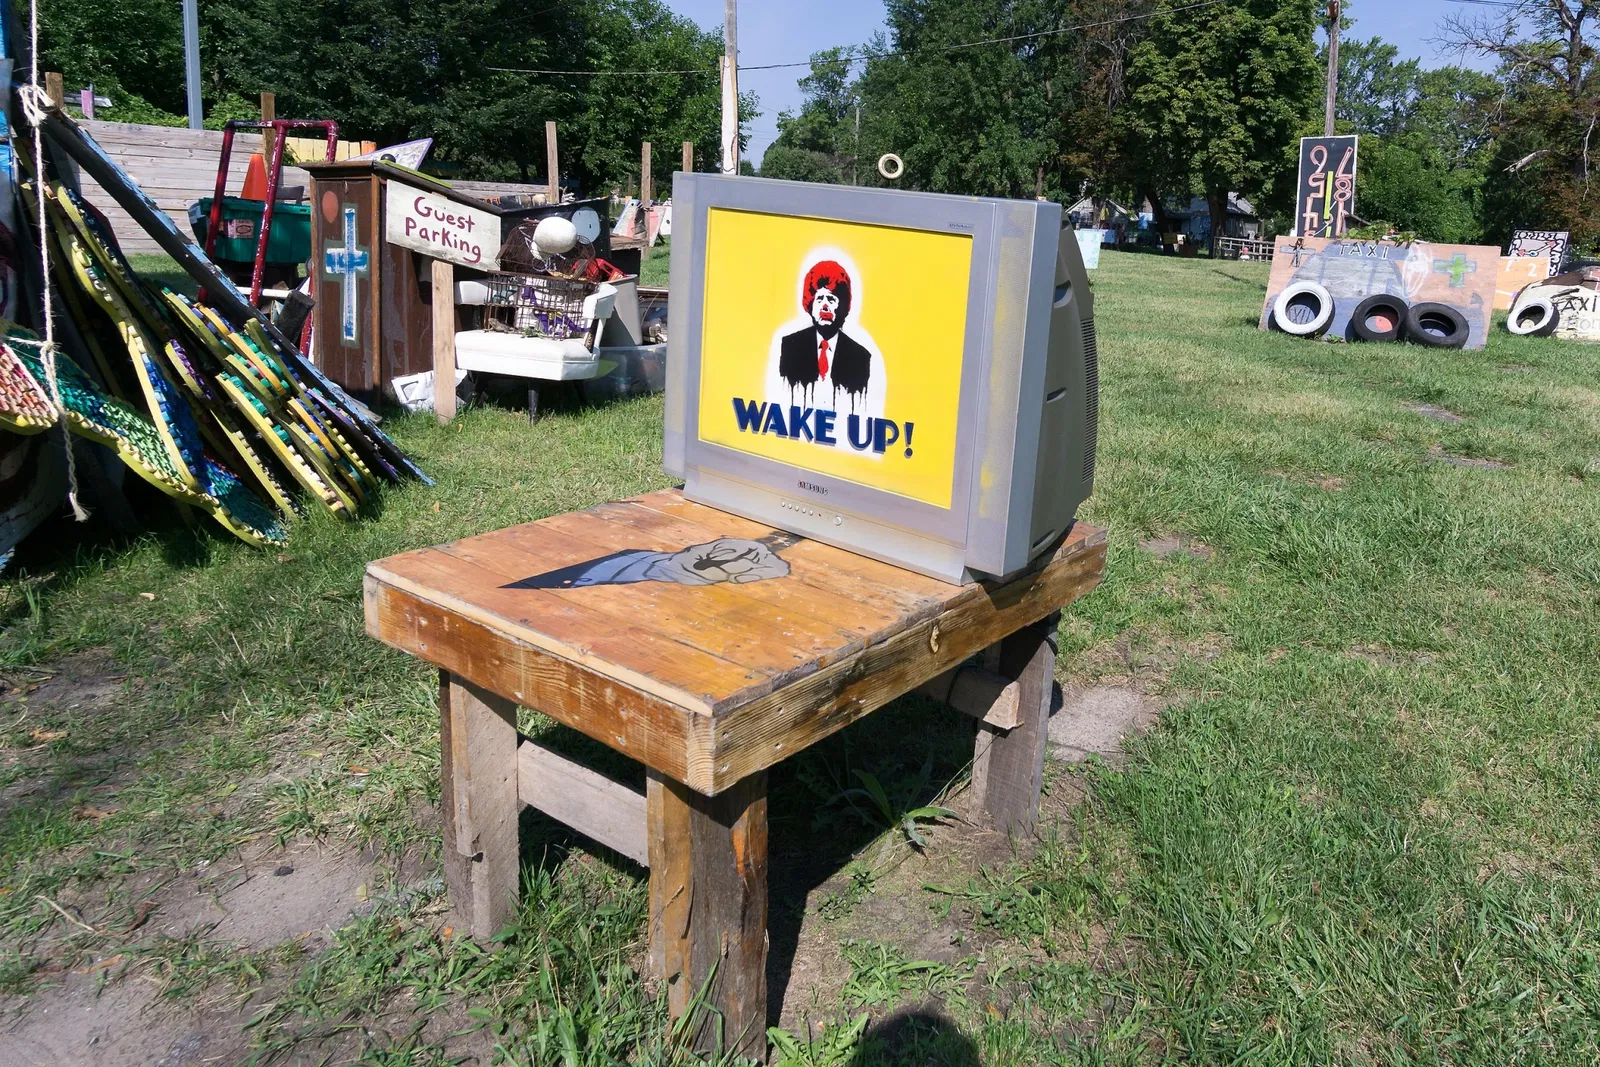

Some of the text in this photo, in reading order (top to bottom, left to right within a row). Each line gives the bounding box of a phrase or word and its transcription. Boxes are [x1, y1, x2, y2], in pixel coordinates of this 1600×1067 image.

[414, 196, 475, 233] Guest
[405, 216, 482, 264] Parking
[1339, 243, 1389, 259] TAXI
[732, 397, 915, 459] WAKE UP!
